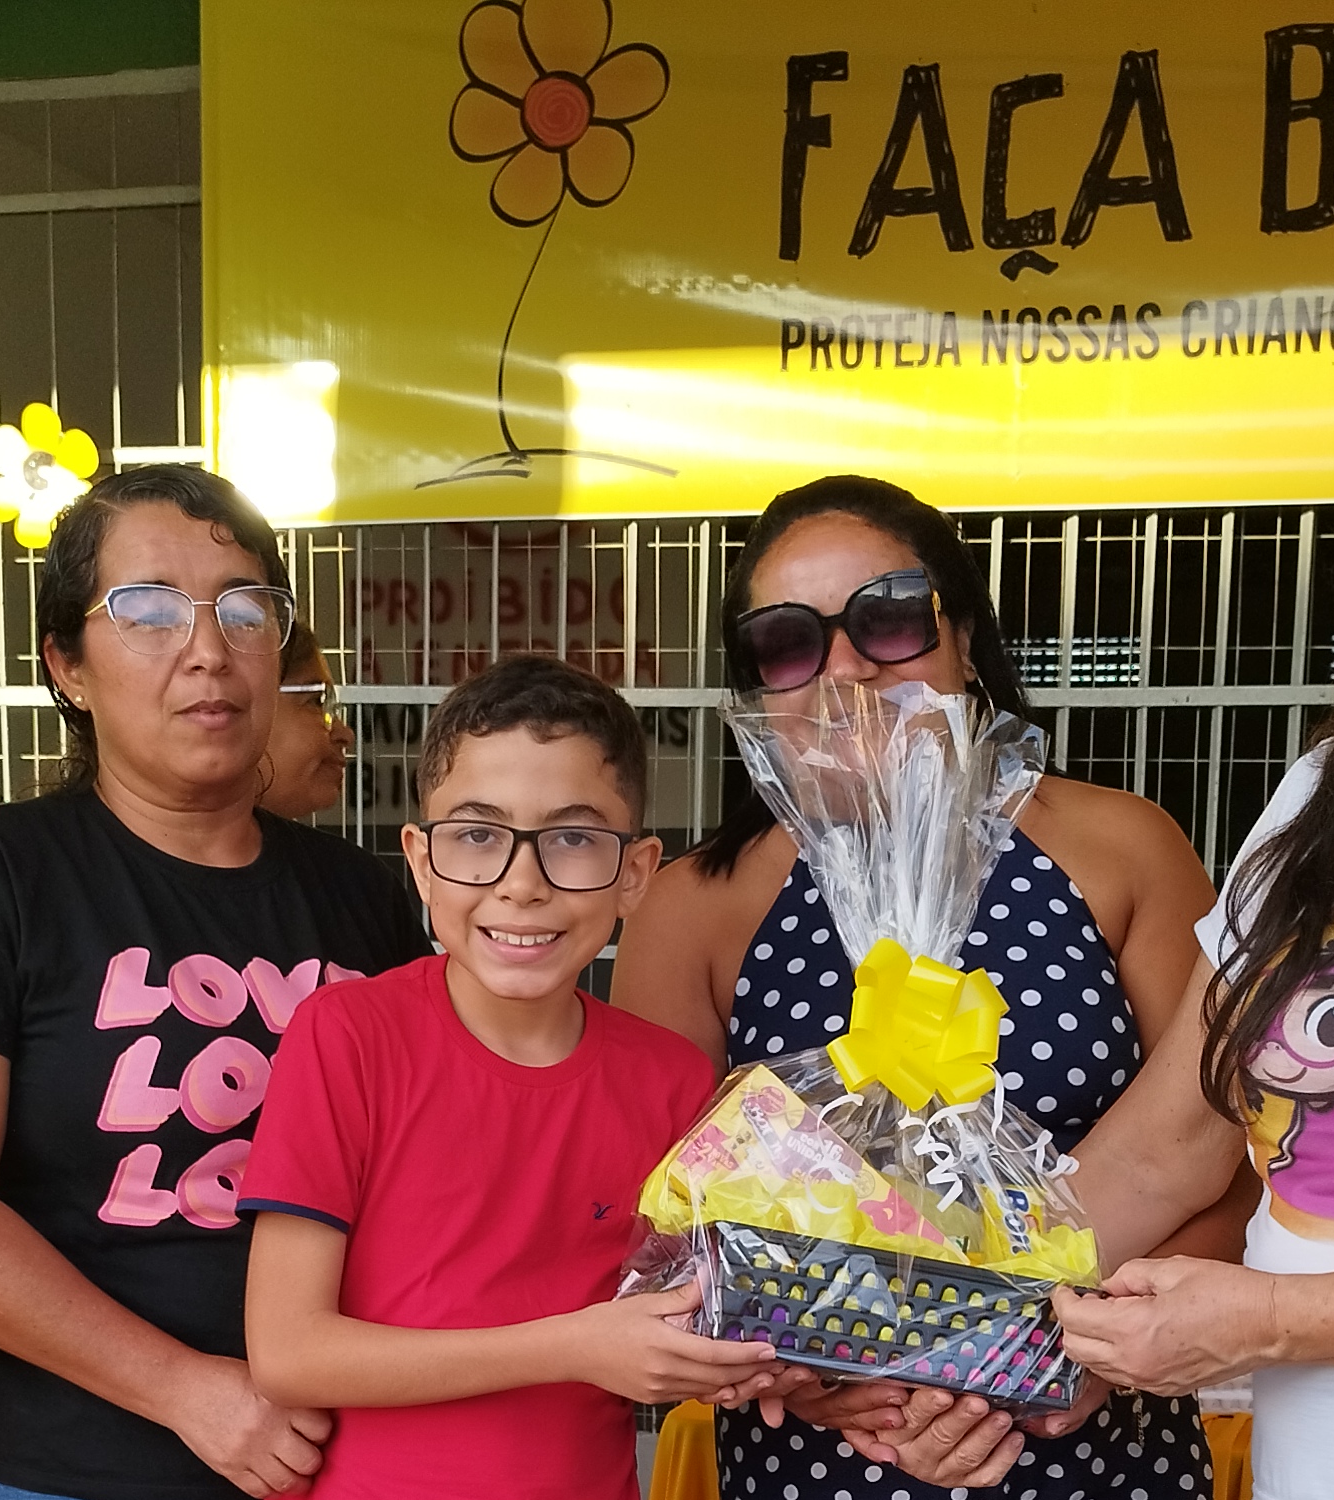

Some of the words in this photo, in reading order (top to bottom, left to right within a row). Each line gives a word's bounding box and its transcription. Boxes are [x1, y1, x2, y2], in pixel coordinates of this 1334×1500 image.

[779, 49, 1193, 282] FAÇA
[781, 311, 962, 372] PROTEJA
[982, 302, 1162, 366] NOSSAS
[94, 947, 367, 1034] LOV
